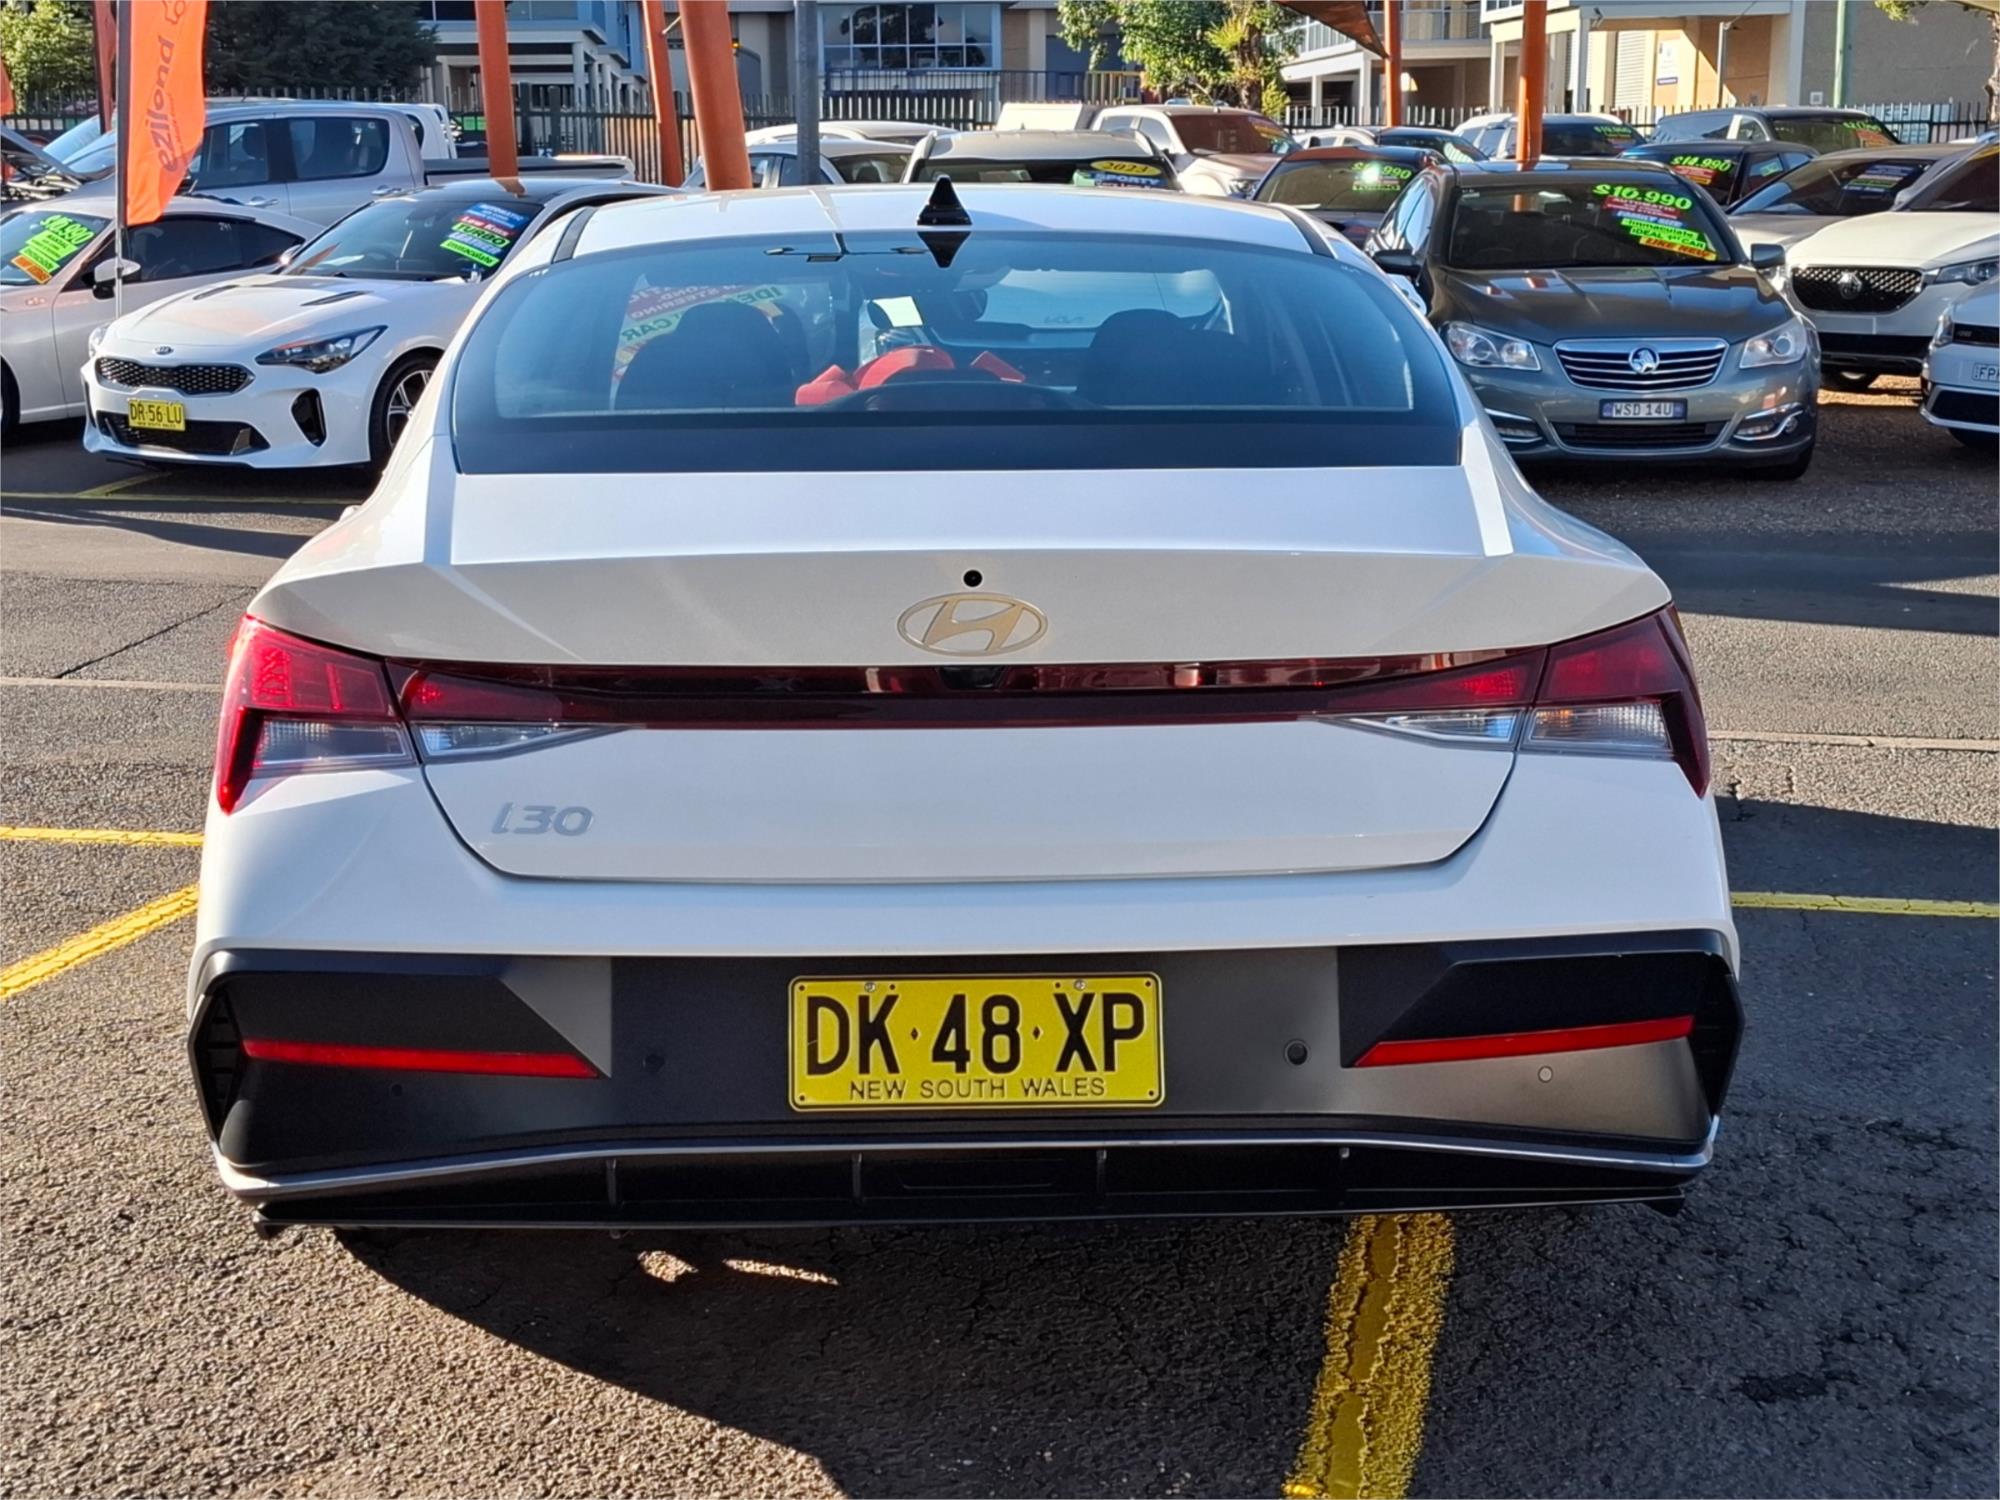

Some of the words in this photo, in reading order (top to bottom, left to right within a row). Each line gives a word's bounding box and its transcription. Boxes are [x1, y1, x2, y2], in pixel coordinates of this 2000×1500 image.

[458, 224, 506, 246] TURBO
[807, 994, 900, 1075] DK
[932, 993, 1021, 1074] 48
[1053, 992, 1145, 1073] XP
[850, 1080, 906, 1100] NEW
[920, 1078, 1005, 1098] SOUTH
[1021, 1077, 1105, 1097] WALES
